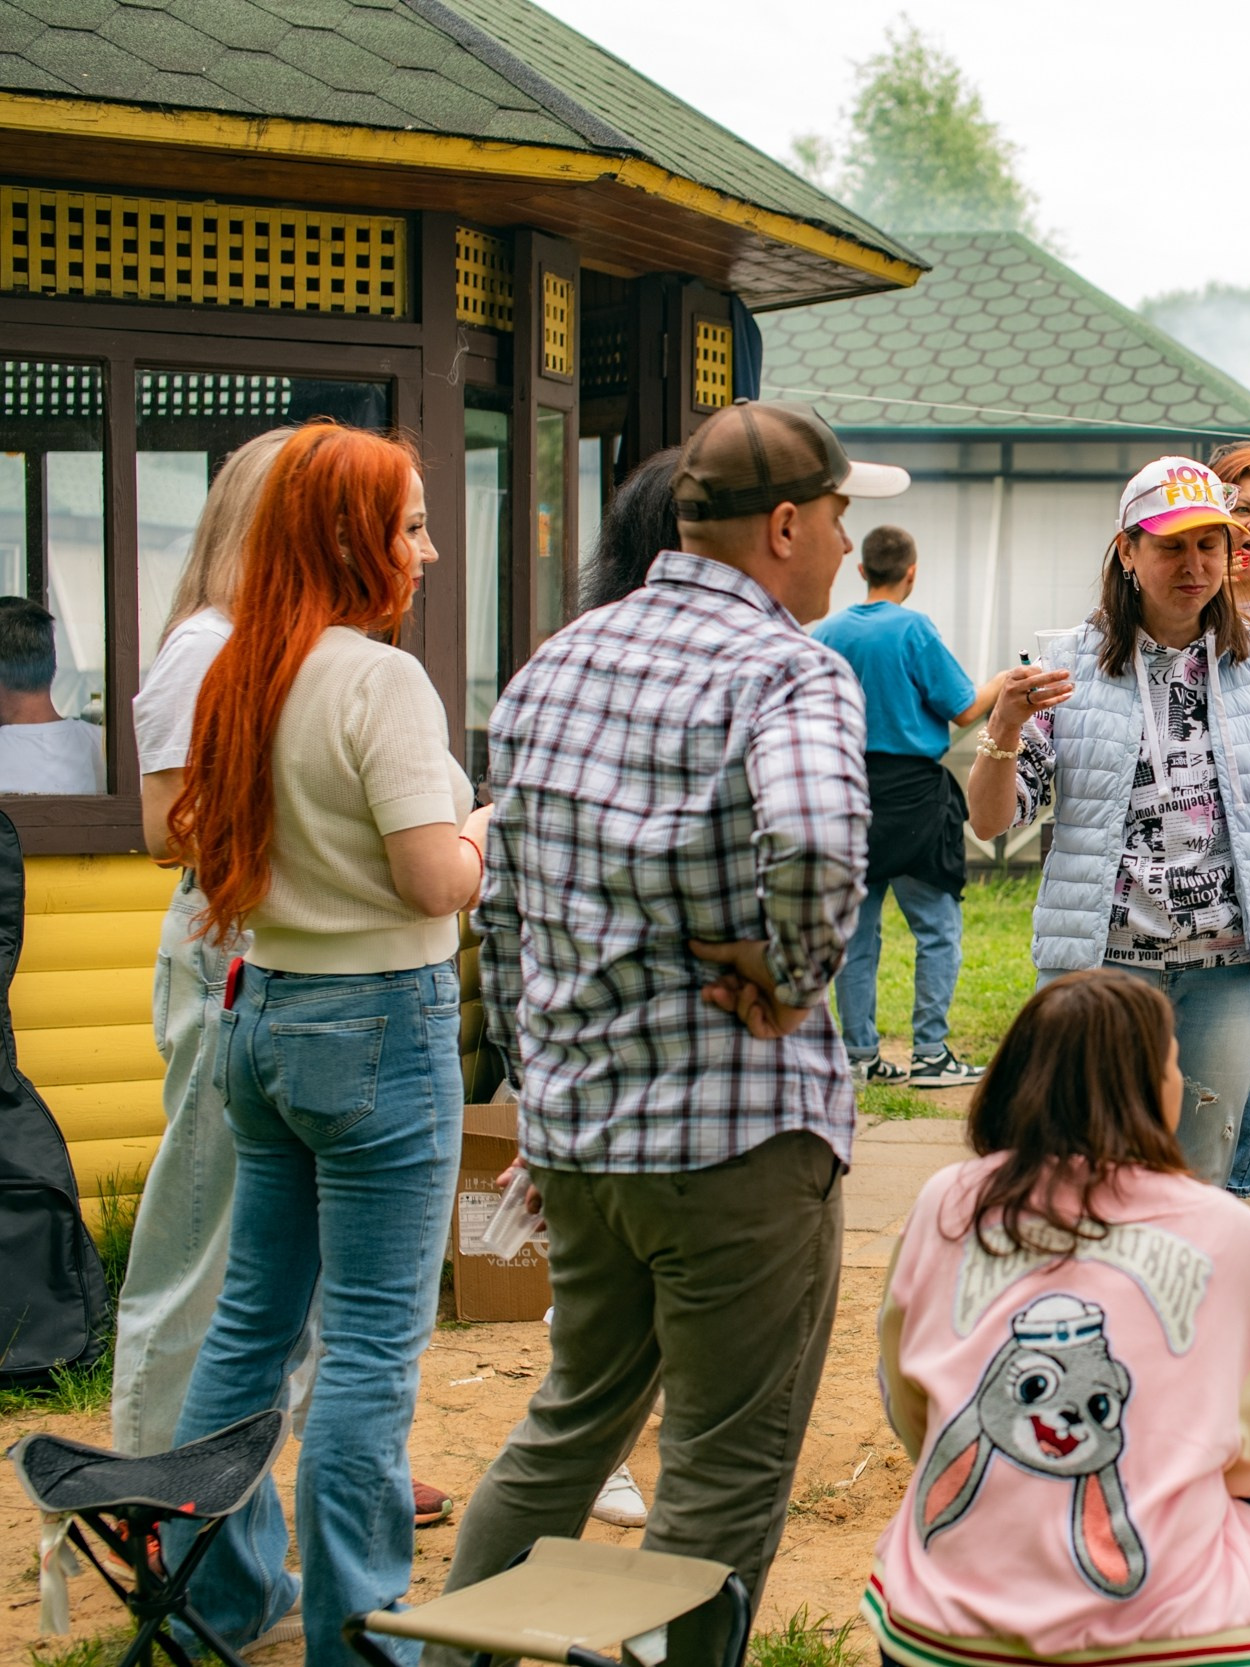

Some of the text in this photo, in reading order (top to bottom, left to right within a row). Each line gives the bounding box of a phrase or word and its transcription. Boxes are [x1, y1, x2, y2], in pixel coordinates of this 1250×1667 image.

[1160, 466, 1209, 488] JOY
[1165, 483, 1219, 506] FUL
[1148, 856, 1165, 895] NEWS
